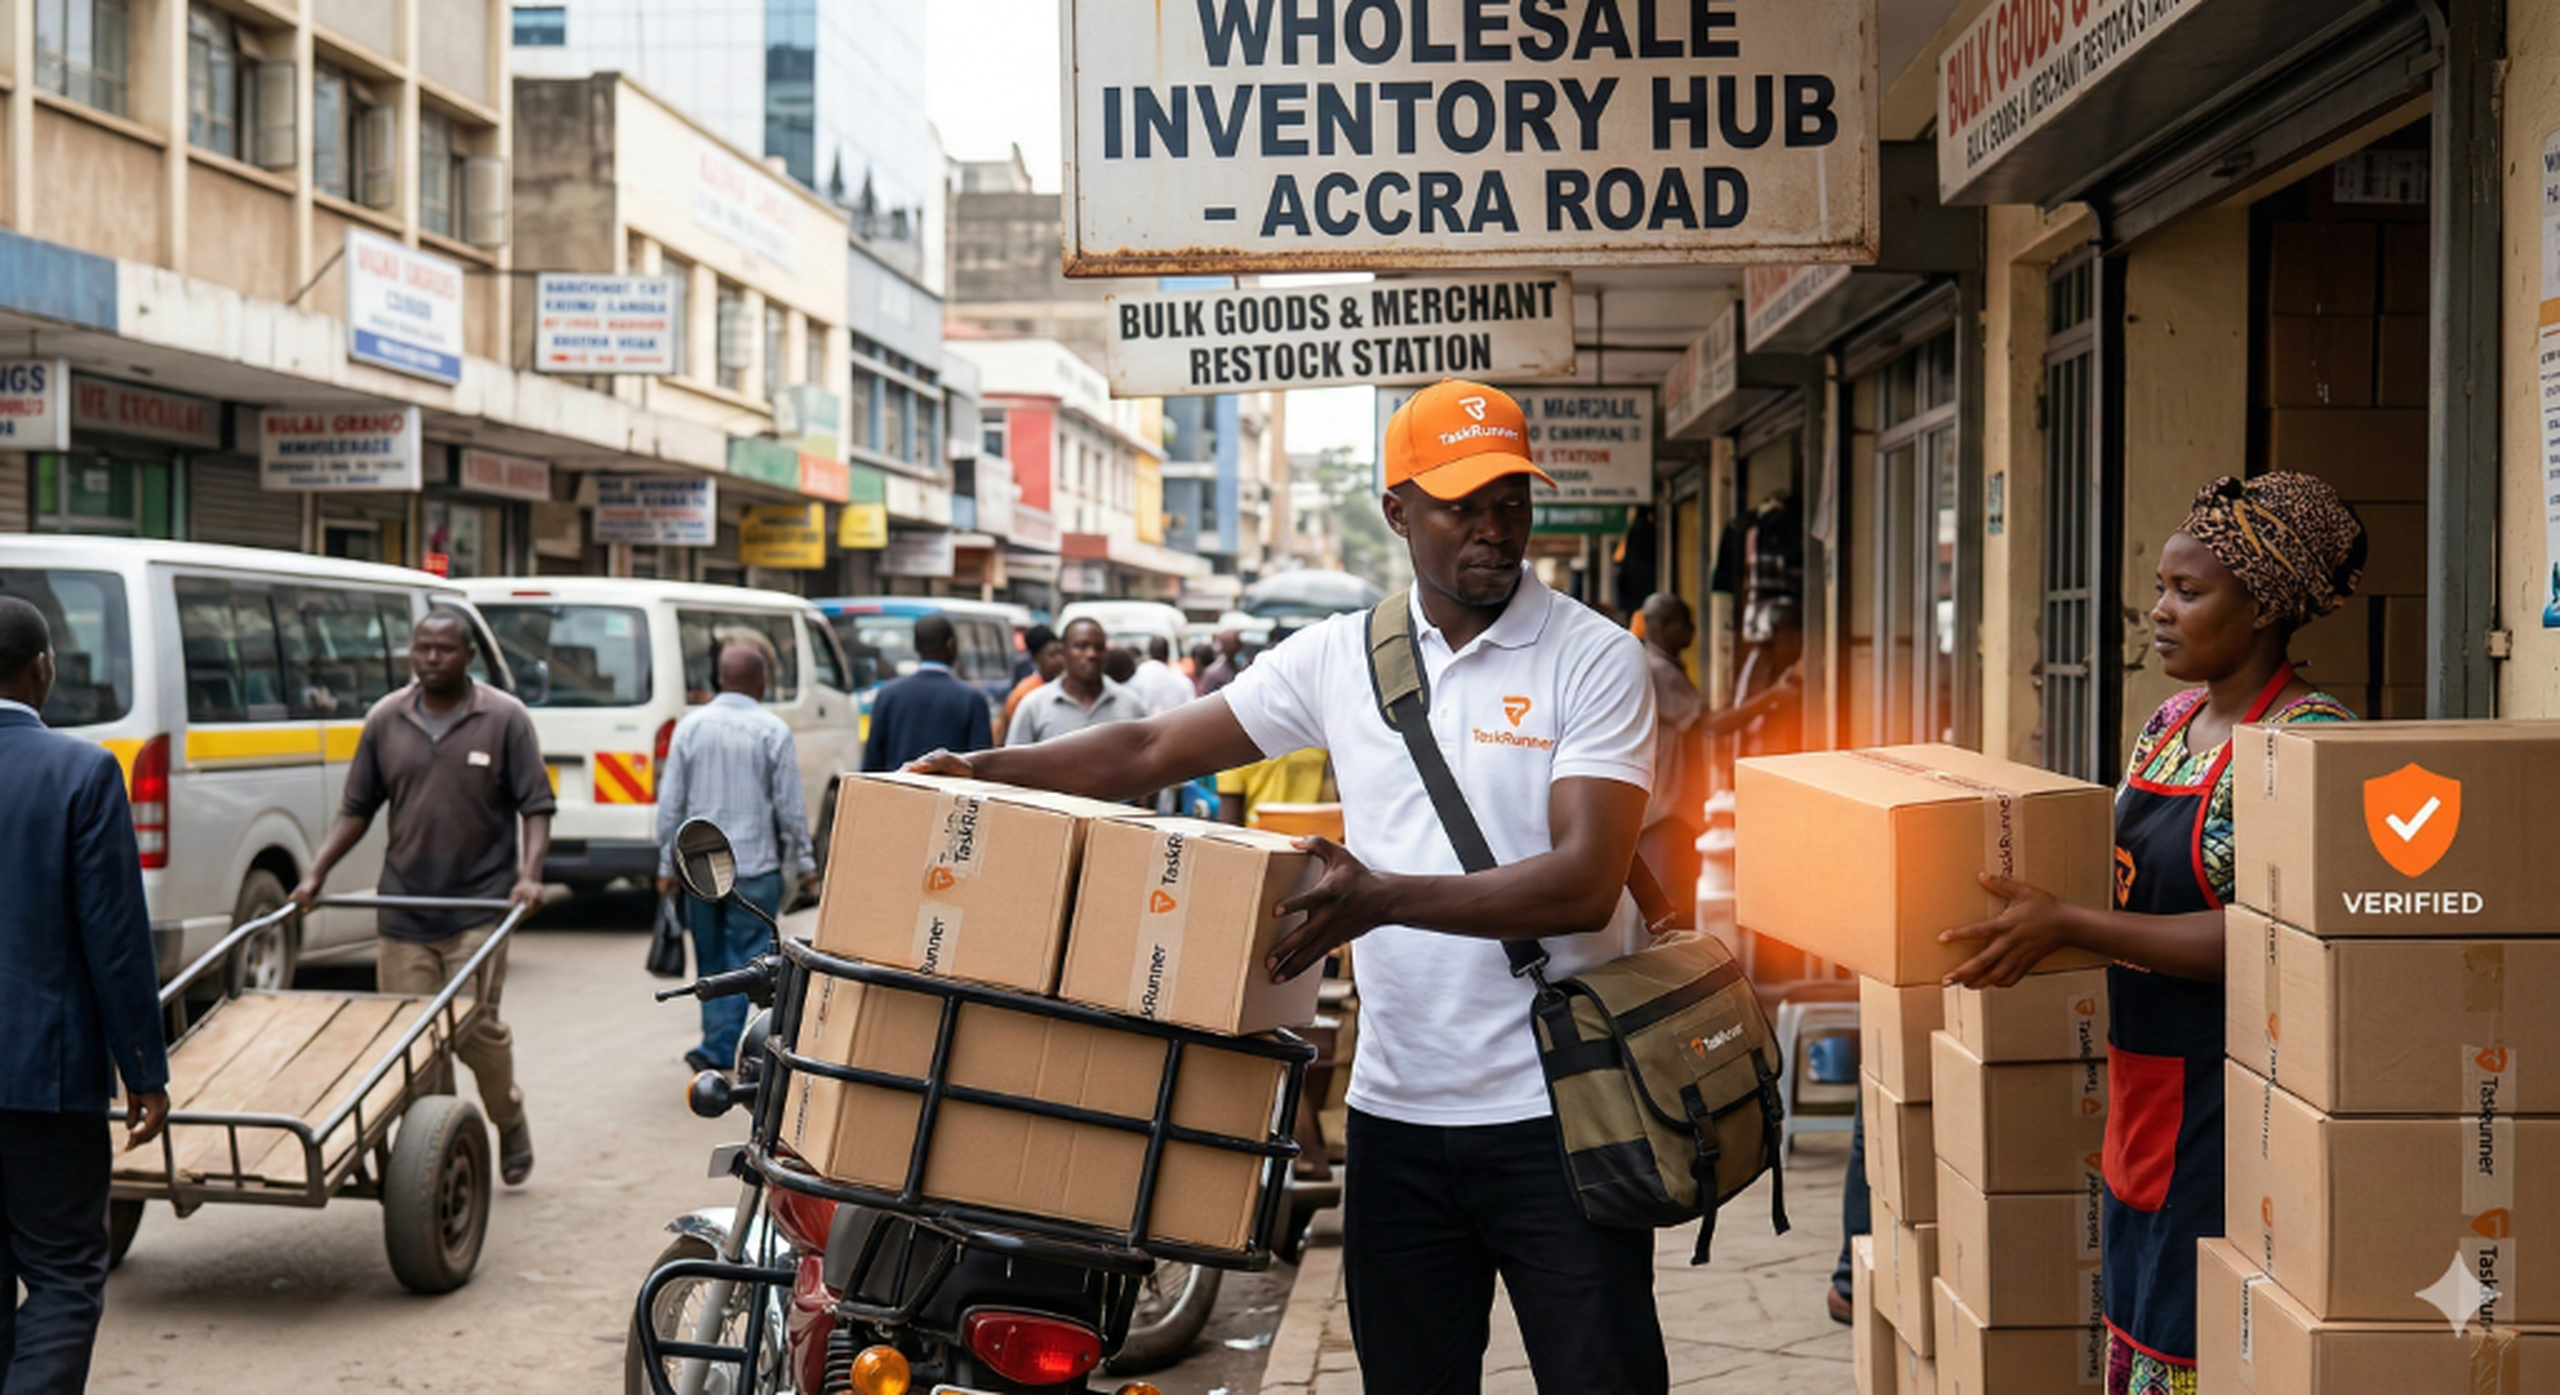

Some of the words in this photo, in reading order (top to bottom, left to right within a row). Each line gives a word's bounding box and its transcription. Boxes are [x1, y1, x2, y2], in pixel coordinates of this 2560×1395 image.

[1198, 0, 1740, 66] WHOLESALE
[2029, 41, 2081, 118] MERCHANT
[2083, 0, 2137, 77] RESTOCK
[1947, 18, 1993, 138] BULK
[1996, 0, 2065, 92] GOODS
[1105, 77, 1620, 158] INVENTORY
[1652, 74, 1838, 150] HUB
[1261, 171, 1518, 236] ACCRA
[1546, 166, 1749, 231] ROAD
[1120, 302, 1205, 340] BULK
[1215, 294, 1330, 336] GOODS
[1340, 297, 1363, 329] &
[1372, 281, 1557, 327] MERCHANT
[1190, 341, 1343, 385] RESTOCK
[1352, 334, 1492, 376] STATION
[1472, 728, 1555, 750] TaskRunner
